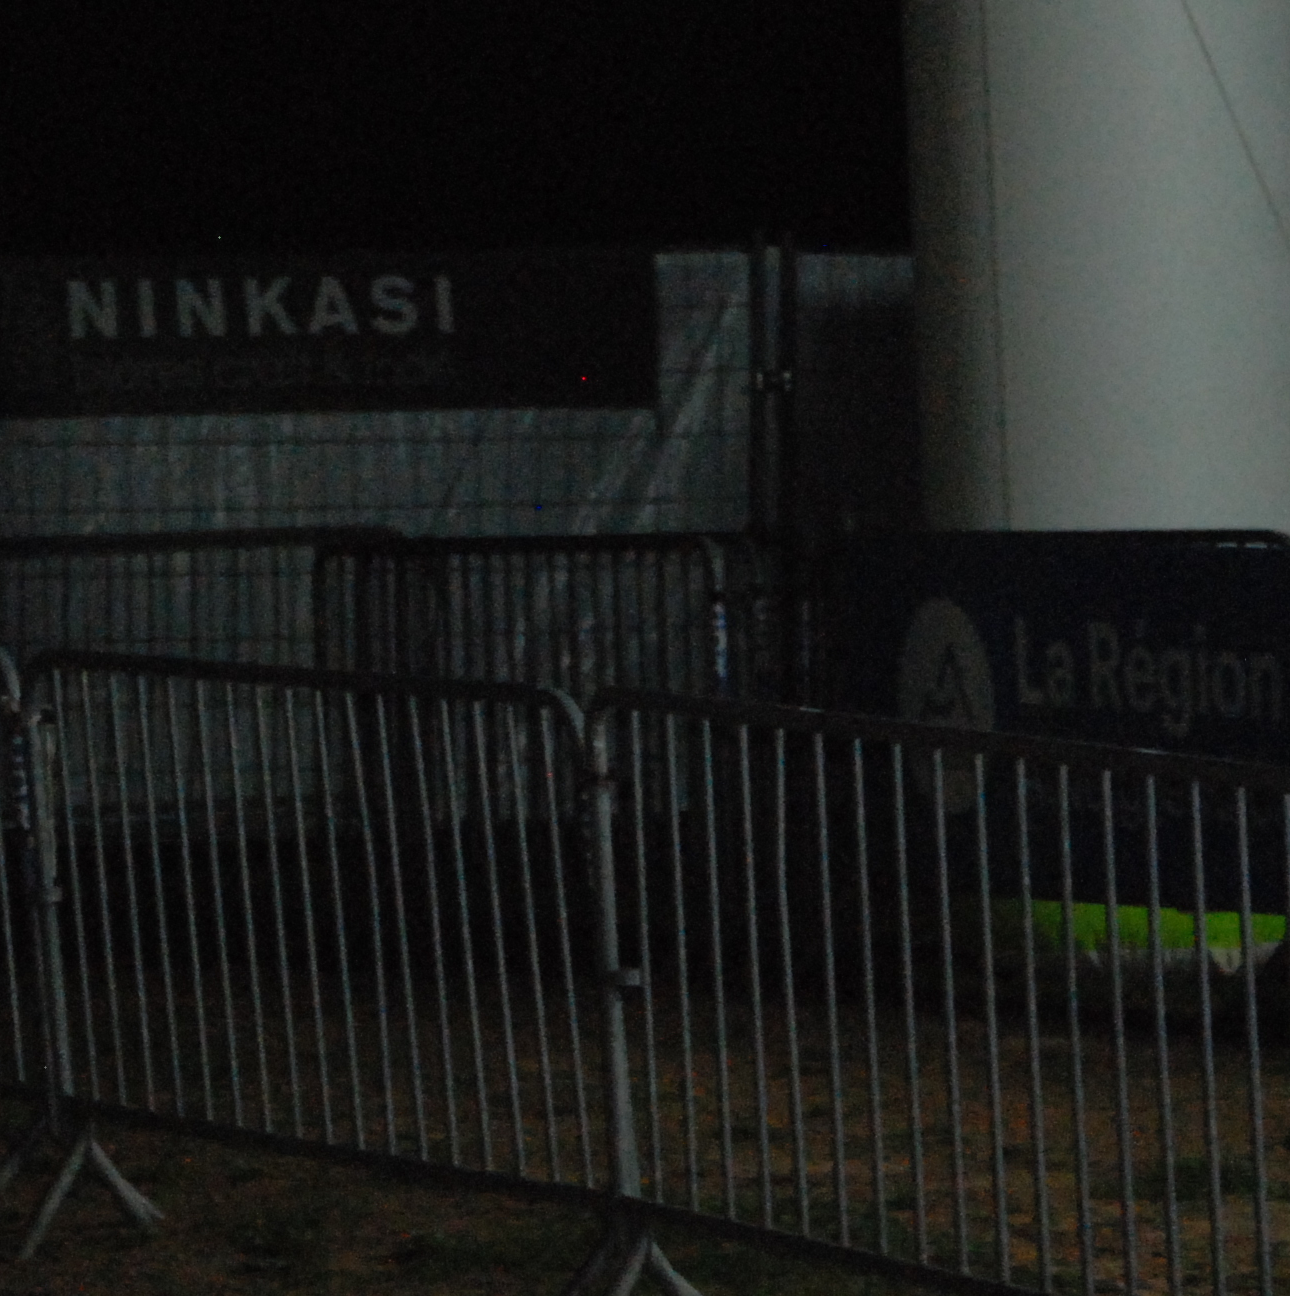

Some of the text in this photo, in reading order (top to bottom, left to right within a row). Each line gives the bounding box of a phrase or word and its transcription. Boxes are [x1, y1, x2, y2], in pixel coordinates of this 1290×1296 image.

[66, 274, 457, 340] NINKASI
[1015, 612, 1285, 738] La Région
